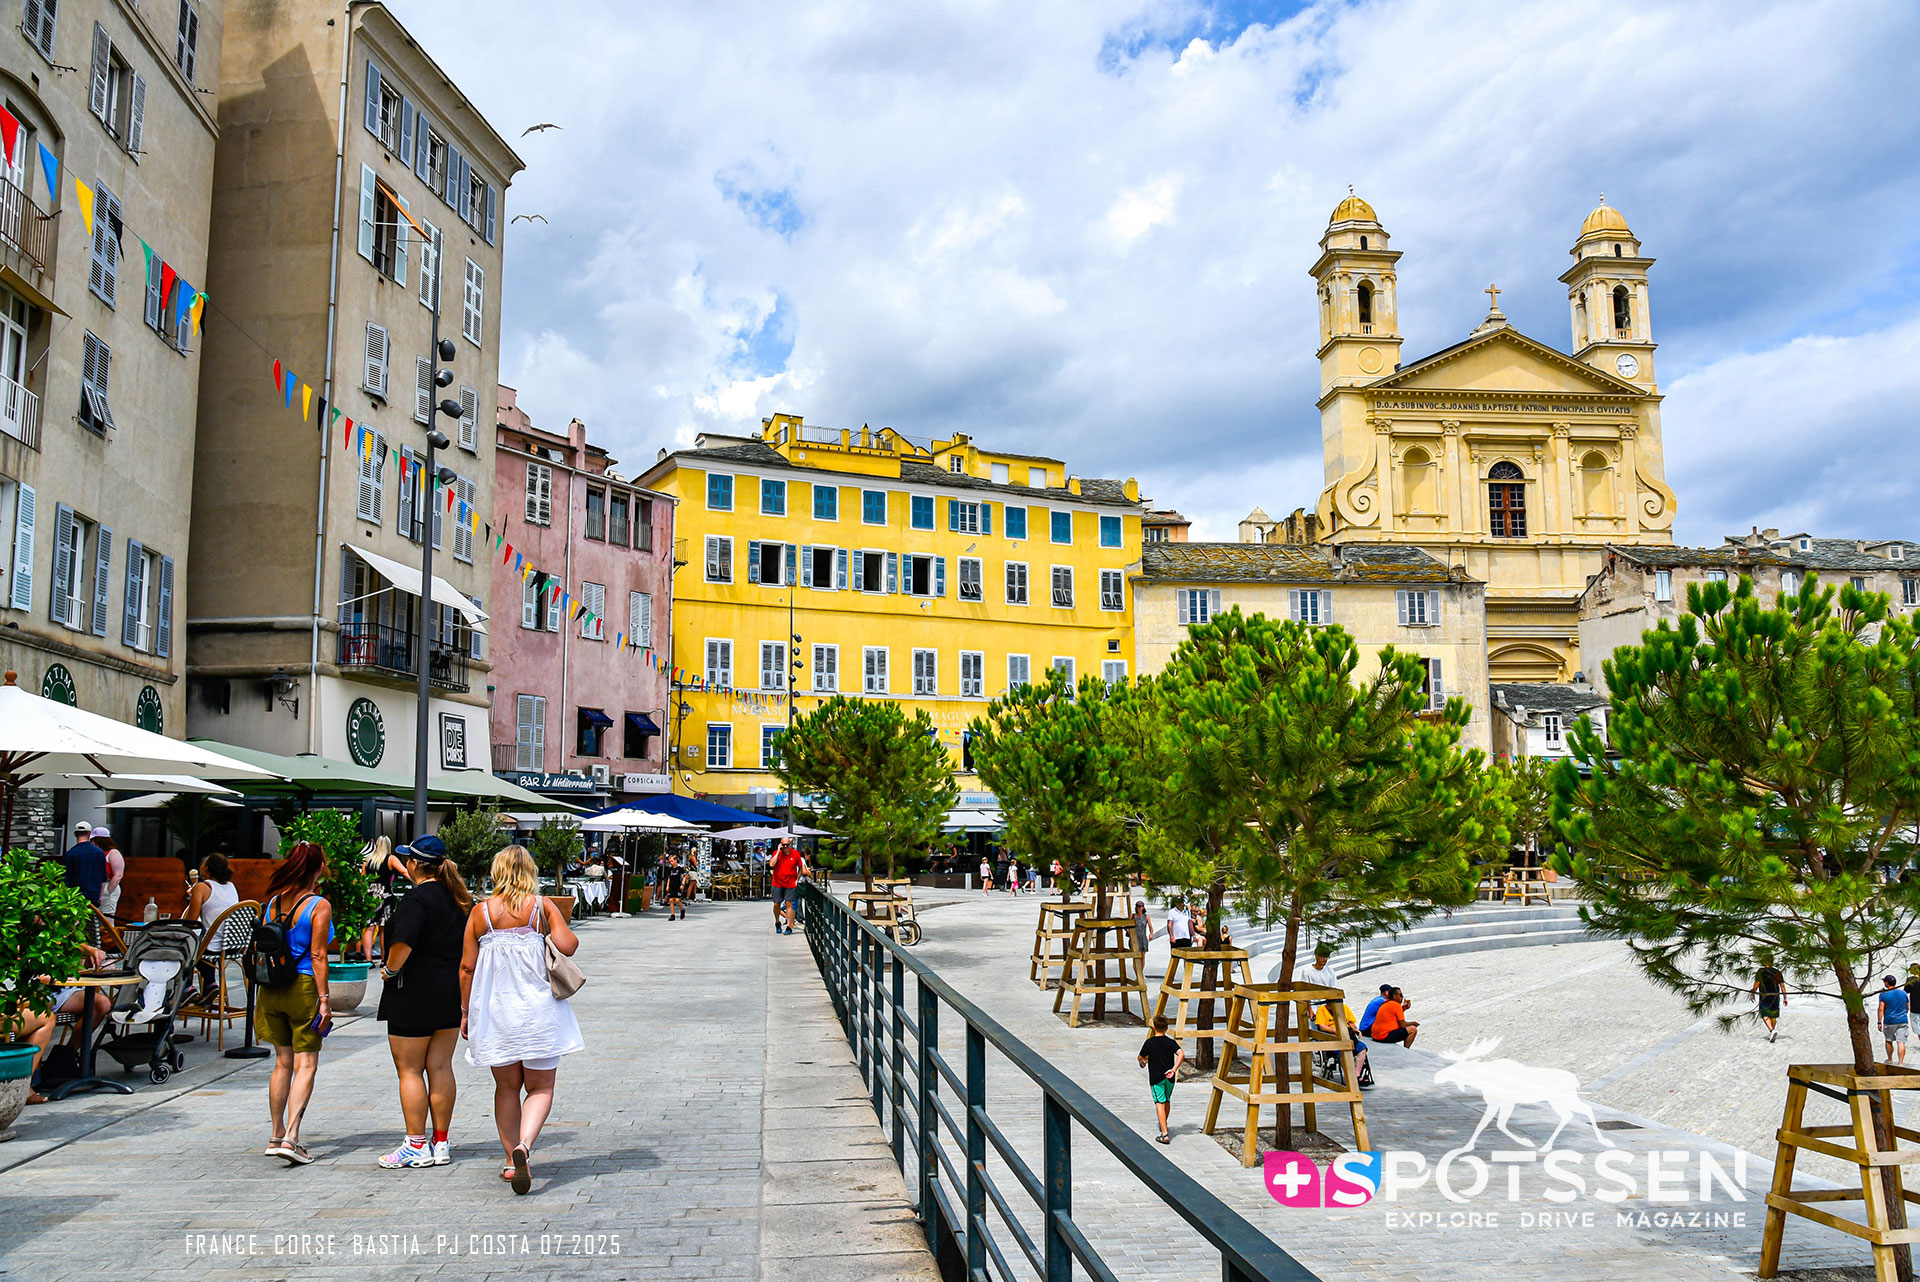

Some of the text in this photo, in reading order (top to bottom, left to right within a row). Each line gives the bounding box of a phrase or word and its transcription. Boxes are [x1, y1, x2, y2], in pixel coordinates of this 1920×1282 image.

[1521, 404, 1549, 412] PATRONI
[1551, 405, 1595, 413] PRINCIPALIS
[1597, 406, 1631, 414] CIVITATIS
[43, 666, 76, 702] OTTIMO
[137, 688, 162, 719] OTTIMO
[351, 701, 386, 732] OTTIMO
[520, 775, 540, 787] BAR
[627, 777, 654, 785] CORSICA
